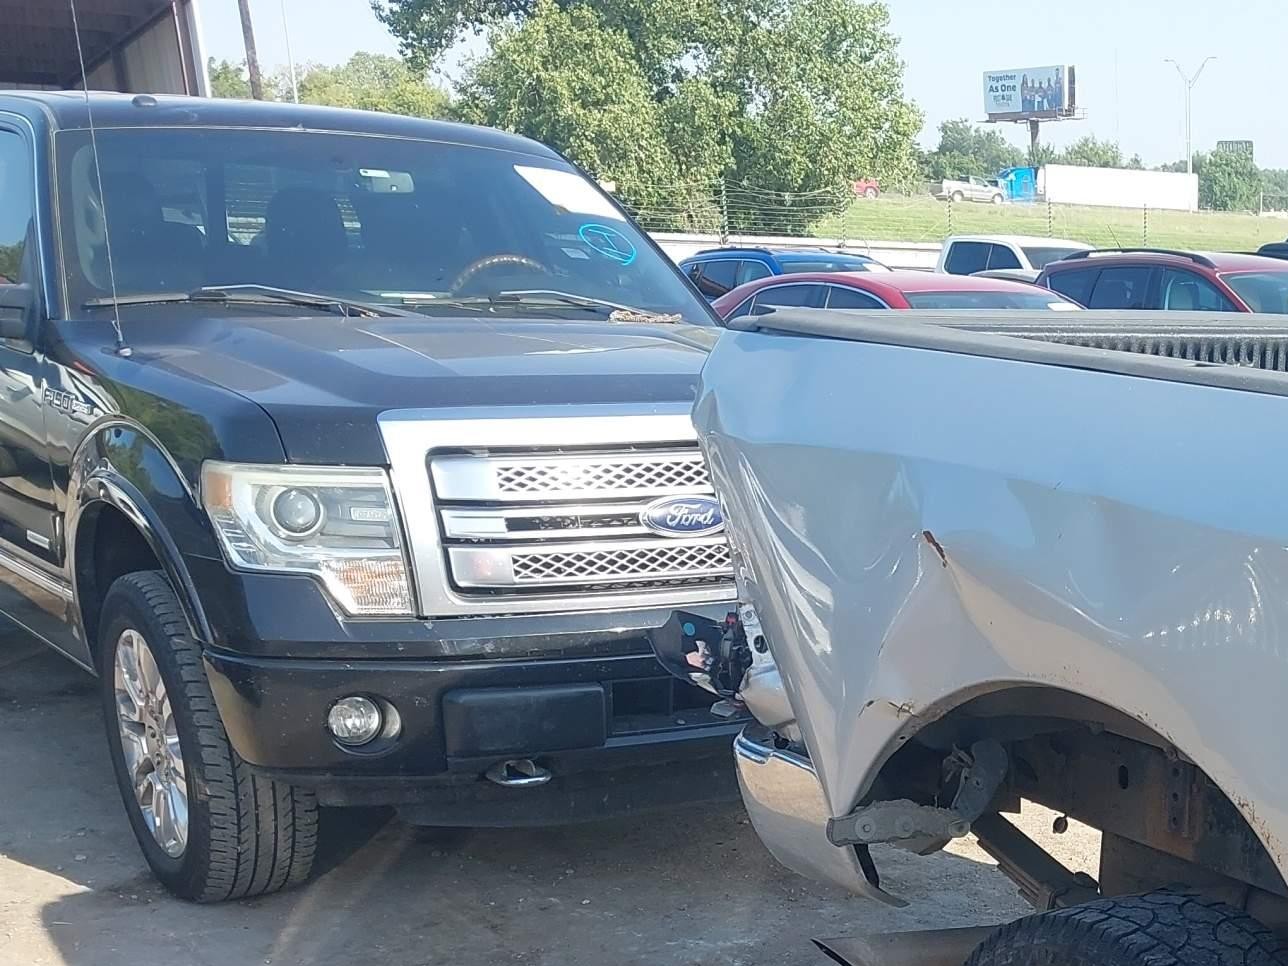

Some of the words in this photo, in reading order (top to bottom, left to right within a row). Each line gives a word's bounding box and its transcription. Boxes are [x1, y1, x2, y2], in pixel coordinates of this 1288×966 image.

[988, 74, 1017, 83] Together
[988, 85, 1000, 93] As
[1000, 84, 1017, 92] One
[666, 503, 714, 527] Ford
